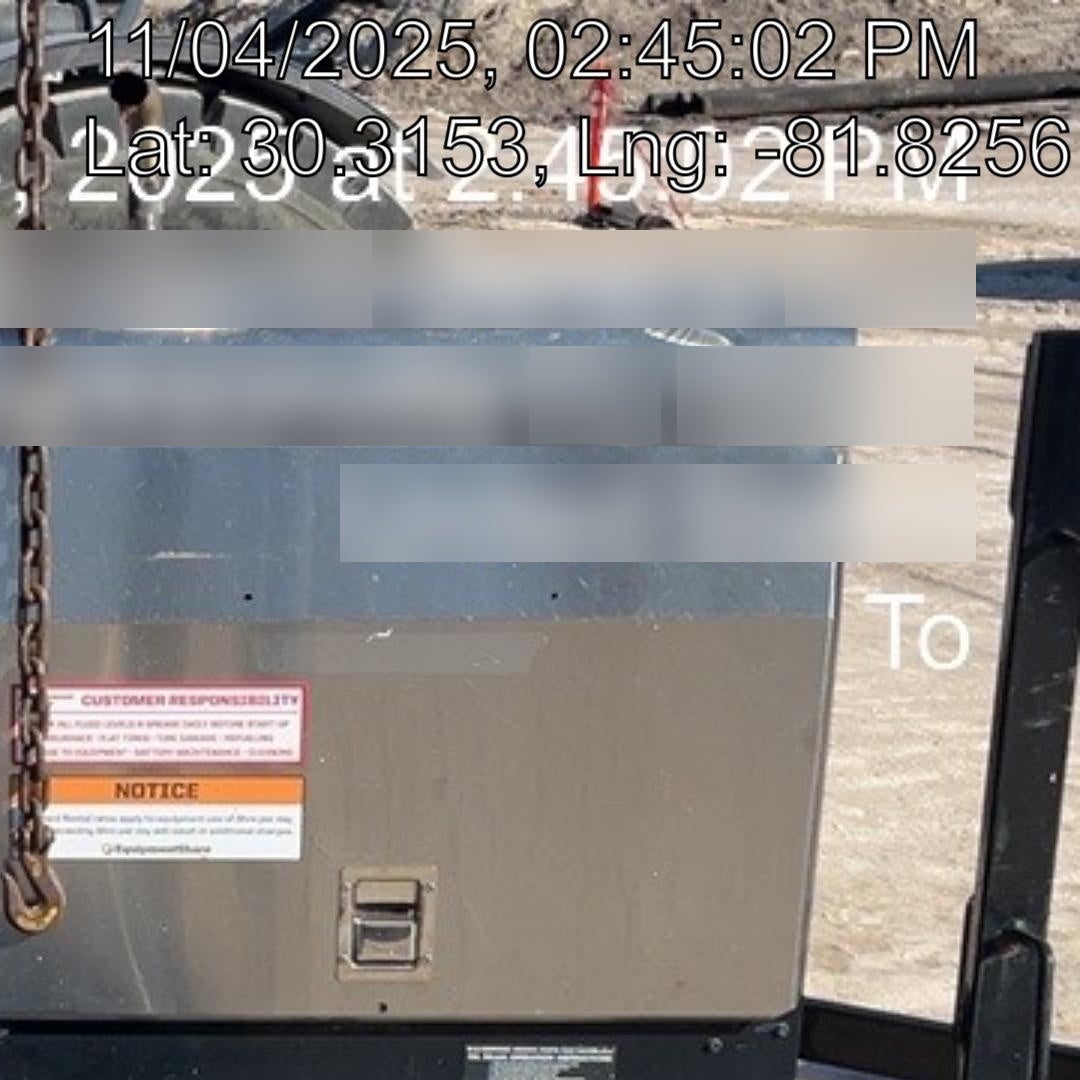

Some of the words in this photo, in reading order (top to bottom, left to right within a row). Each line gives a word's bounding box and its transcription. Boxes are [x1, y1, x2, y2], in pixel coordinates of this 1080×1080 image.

[80, 694, 165, 706] CUSTOMER
[168, 694, 298, 706] RESPONSIBILITY
[114, 782, 199, 799] NOTICE
